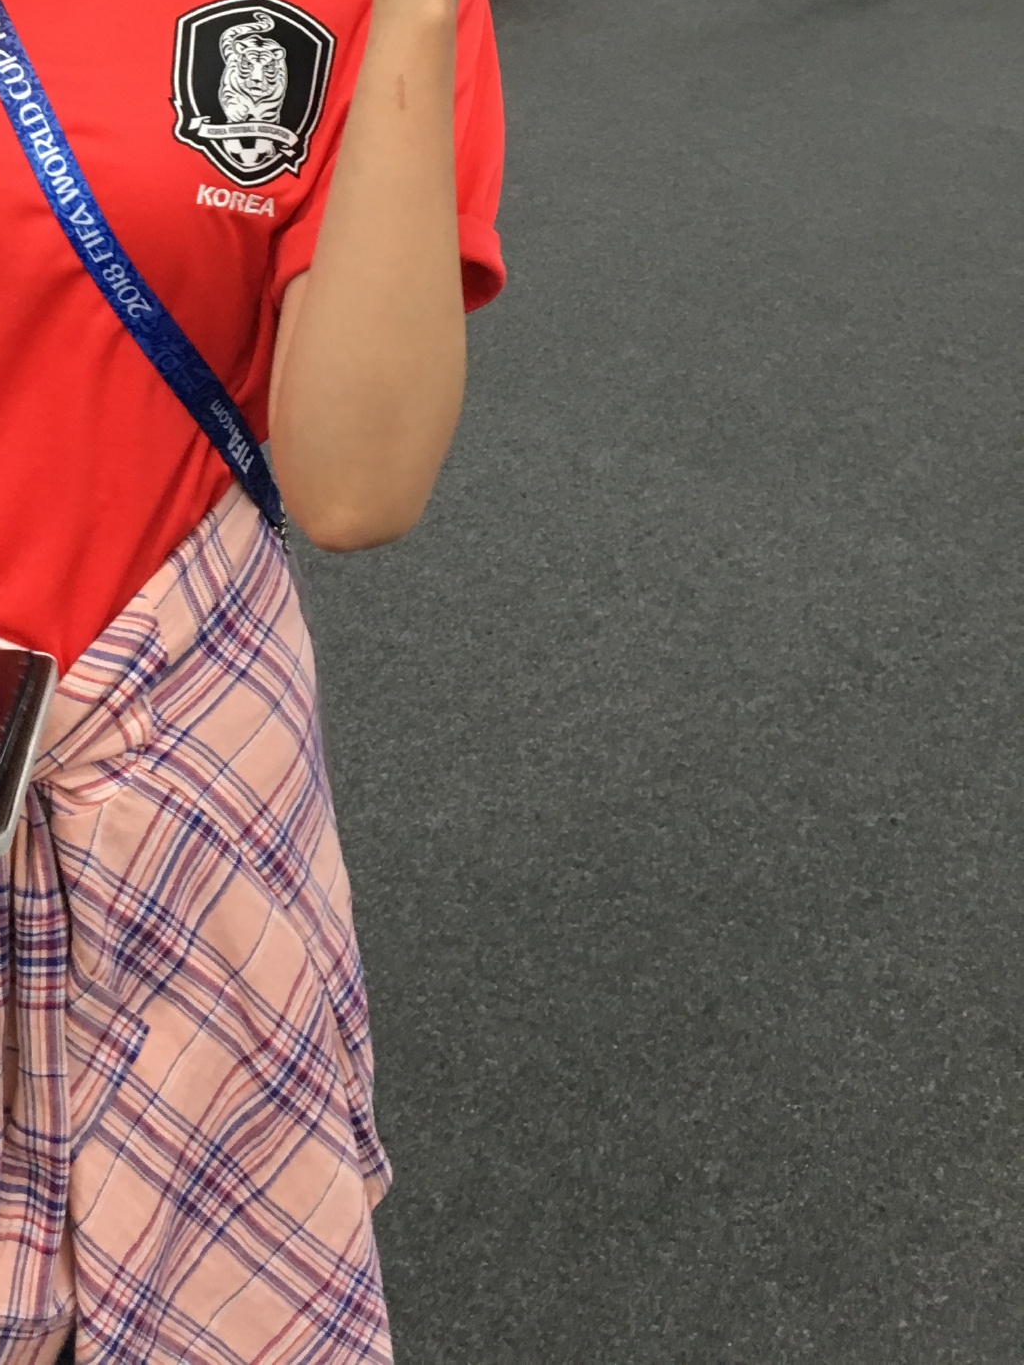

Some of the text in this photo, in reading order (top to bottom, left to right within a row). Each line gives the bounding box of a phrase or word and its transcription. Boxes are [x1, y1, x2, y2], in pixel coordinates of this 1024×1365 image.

[19, 102, 80, 205] WORLD
[196, 184, 275, 217] KOREA
[69, 202, 114, 264] FIFA
[102, 262, 153, 318] 2018
